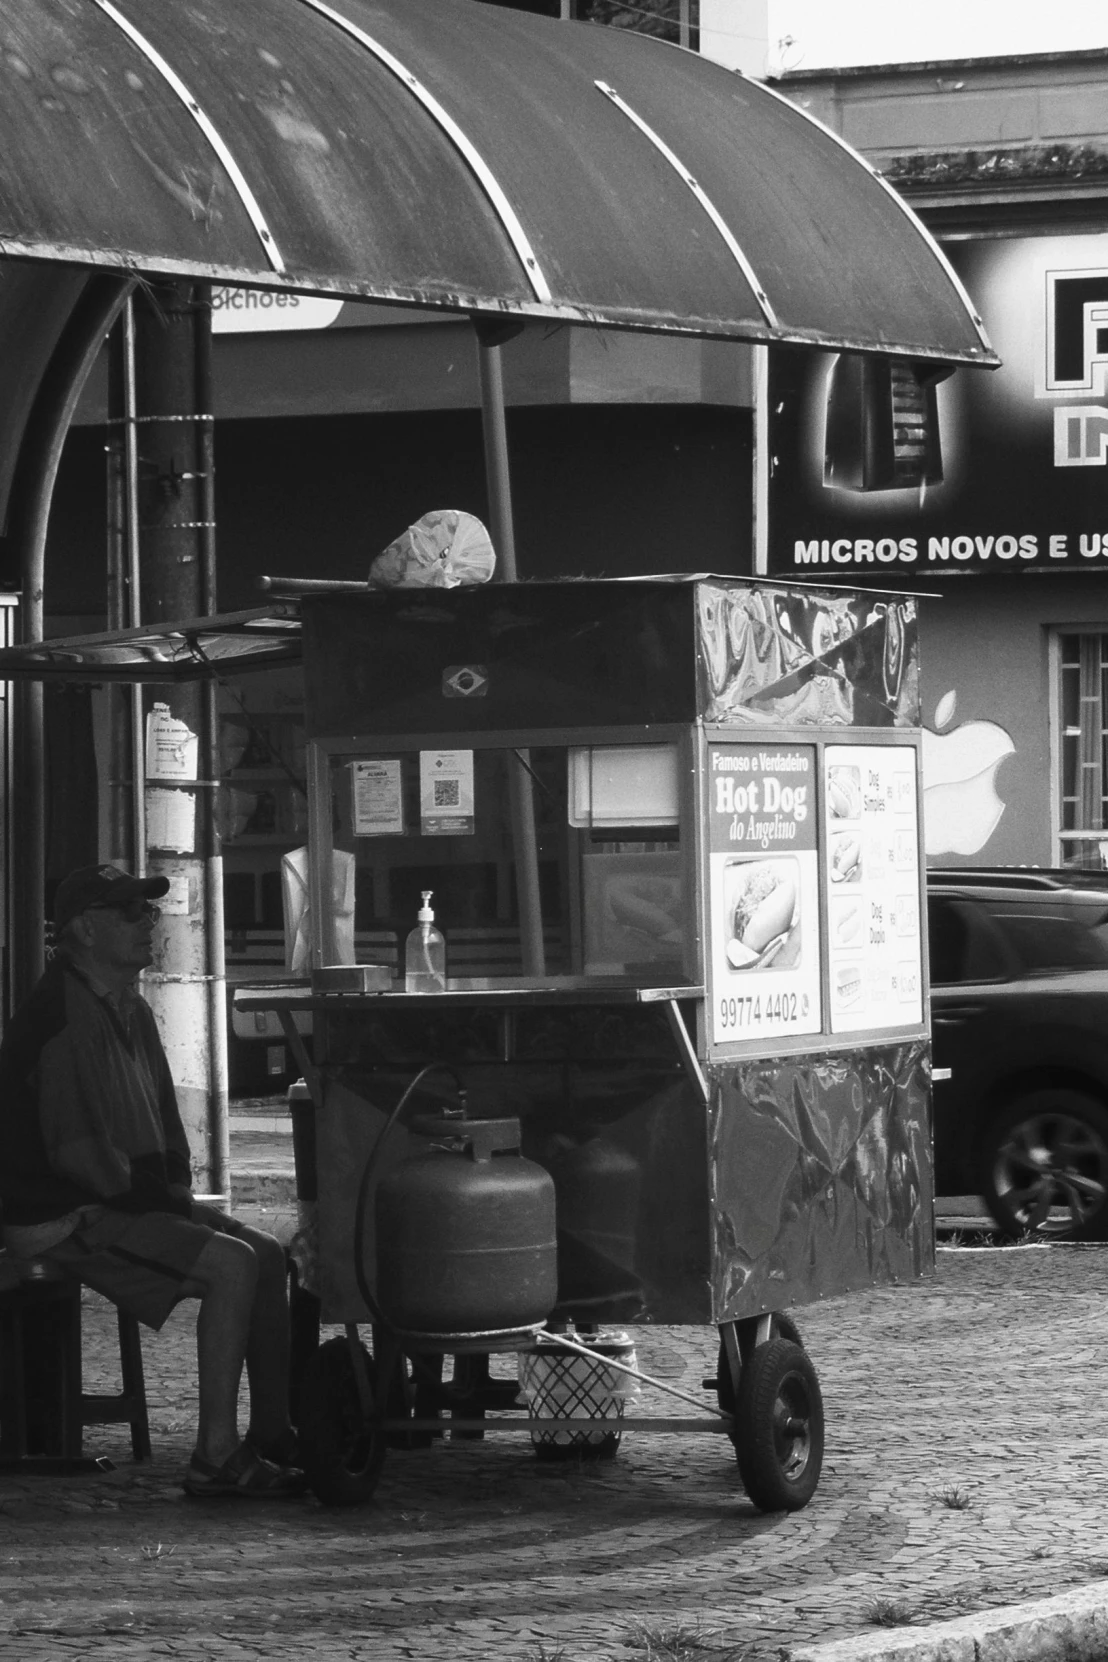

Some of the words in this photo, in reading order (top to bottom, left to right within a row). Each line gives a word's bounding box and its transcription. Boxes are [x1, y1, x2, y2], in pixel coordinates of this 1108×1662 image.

[794, 538, 918, 564] MICROS
[928, 535, 1038, 561] NOVOS
[1049, 534, 1068, 558] E
[712, 752, 750, 771] Famoso
[751, 756, 758, 771] e
[759, 752, 808, 772] Verdadeiro
[715, 777, 759, 813] Hot
[762, 777, 807, 821] Dog
[729, 814, 744, 840] do
[745, 814, 796, 849] Angelino
[720, 995, 761, 1028] 99774
[765, 992, 797, 1024] 4402
